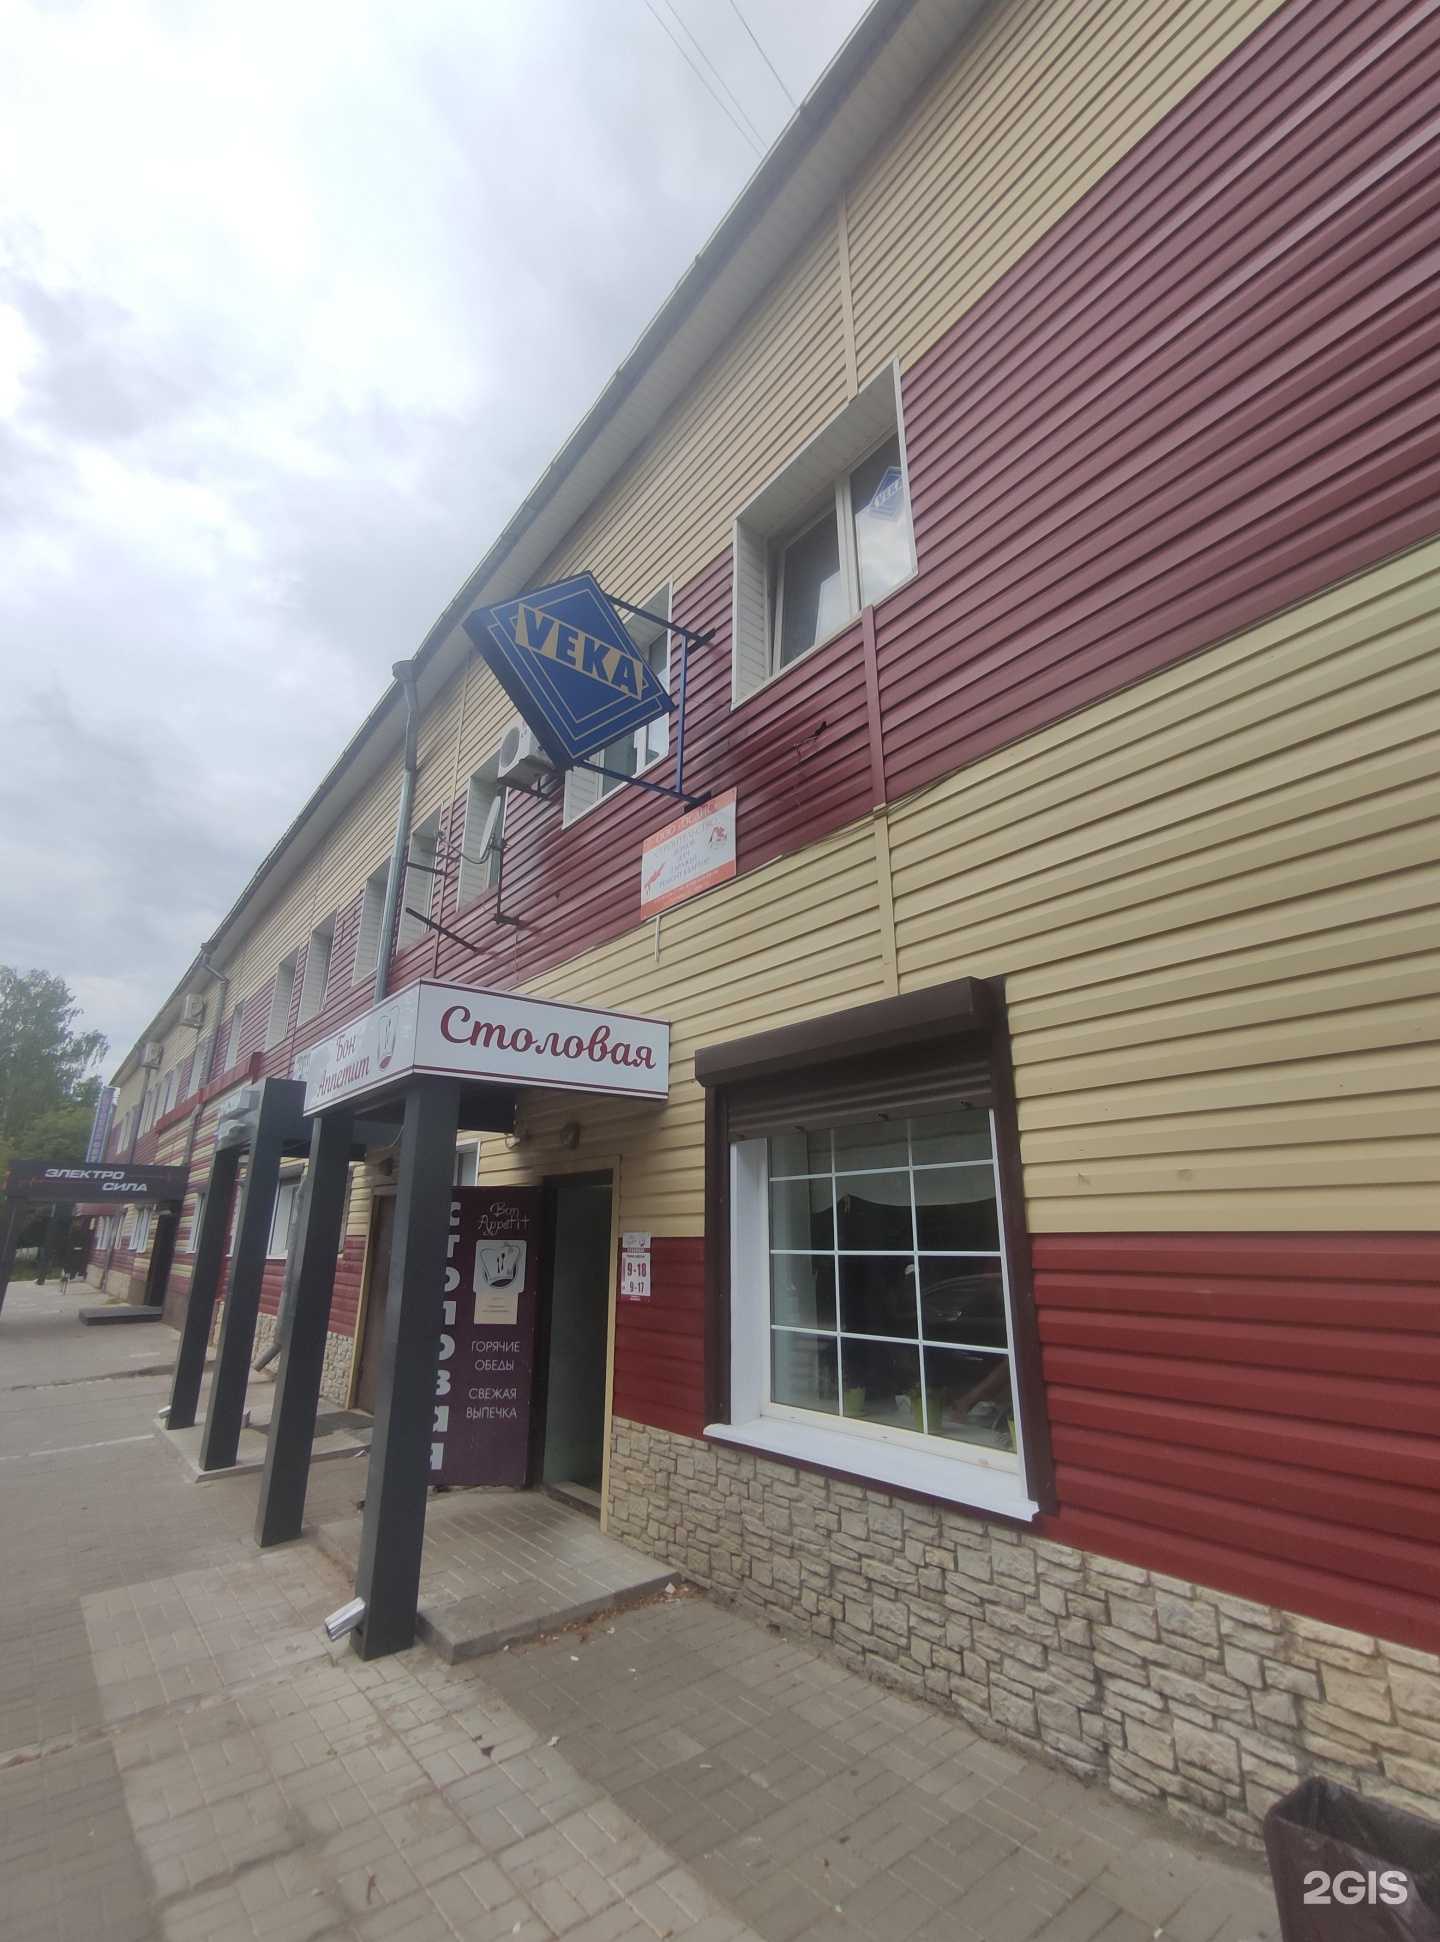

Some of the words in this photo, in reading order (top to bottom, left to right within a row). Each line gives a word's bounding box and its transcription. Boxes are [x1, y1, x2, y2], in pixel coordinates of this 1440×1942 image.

[520, 604, 642, 699] VEKA
[439, 1005, 657, 1070] Столовая
[336, 1033, 357, 1062] Бон
[317, 1055, 370, 1096] Аппетит
[44, 1168, 126, 1180] ЭЛЕКТРО
[102, 1182, 148, 1192] СИЛА
[471, 1341, 521, 1352] ГОРЯЧИЕ
[474, 1360, 515, 1371] ОБЕДЫ
[468, 1387, 517, 1400] СВЕЖАЯ
[466, 1406, 518, 1419] ВЫПЕЧКА
